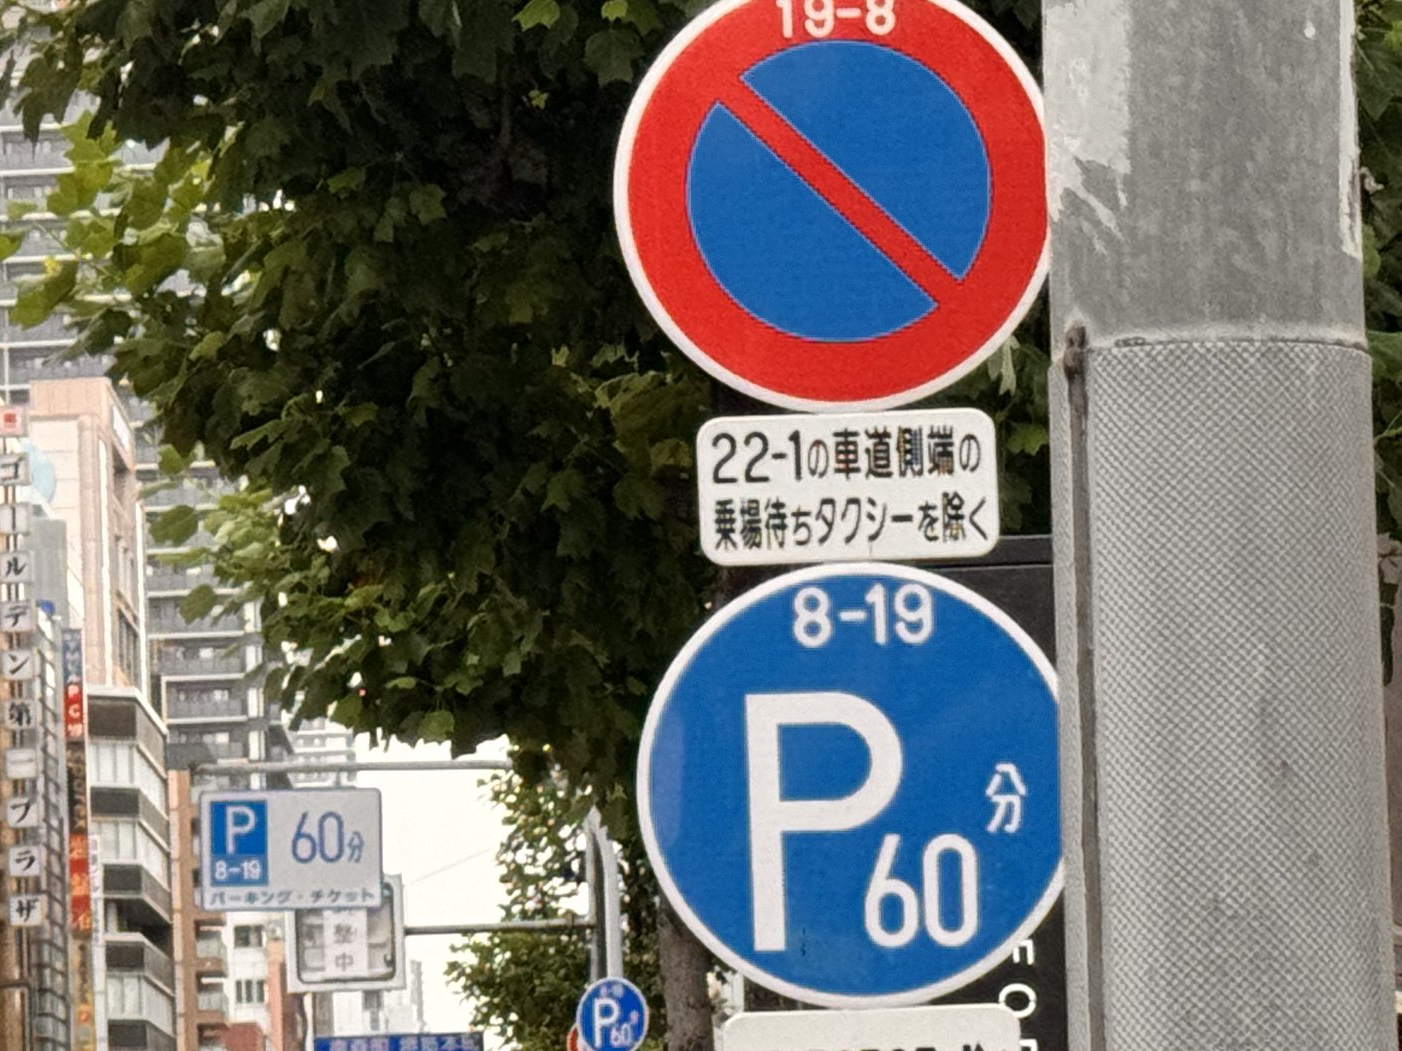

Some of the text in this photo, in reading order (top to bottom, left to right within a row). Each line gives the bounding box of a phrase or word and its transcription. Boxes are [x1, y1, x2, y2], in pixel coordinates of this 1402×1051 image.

[776, 0, 896, 39] 19-8
[710, 424, 981, 485] 22-1の車道側端の
[713, 490, 989, 550] 乗場待ちタクシーを除く
[791, 584, 935, 648] 8-19
[225, 805, 256, 855] P
[291, 811, 365, 865] 60分
[745, 691, 903, 952] P
[214, 861, 262, 881] 8-19
[863, 762, 1026, 949] 60 分
[209, 888, 375, 906] パーキング・チケット
[594, 998, 619, 1048] P
